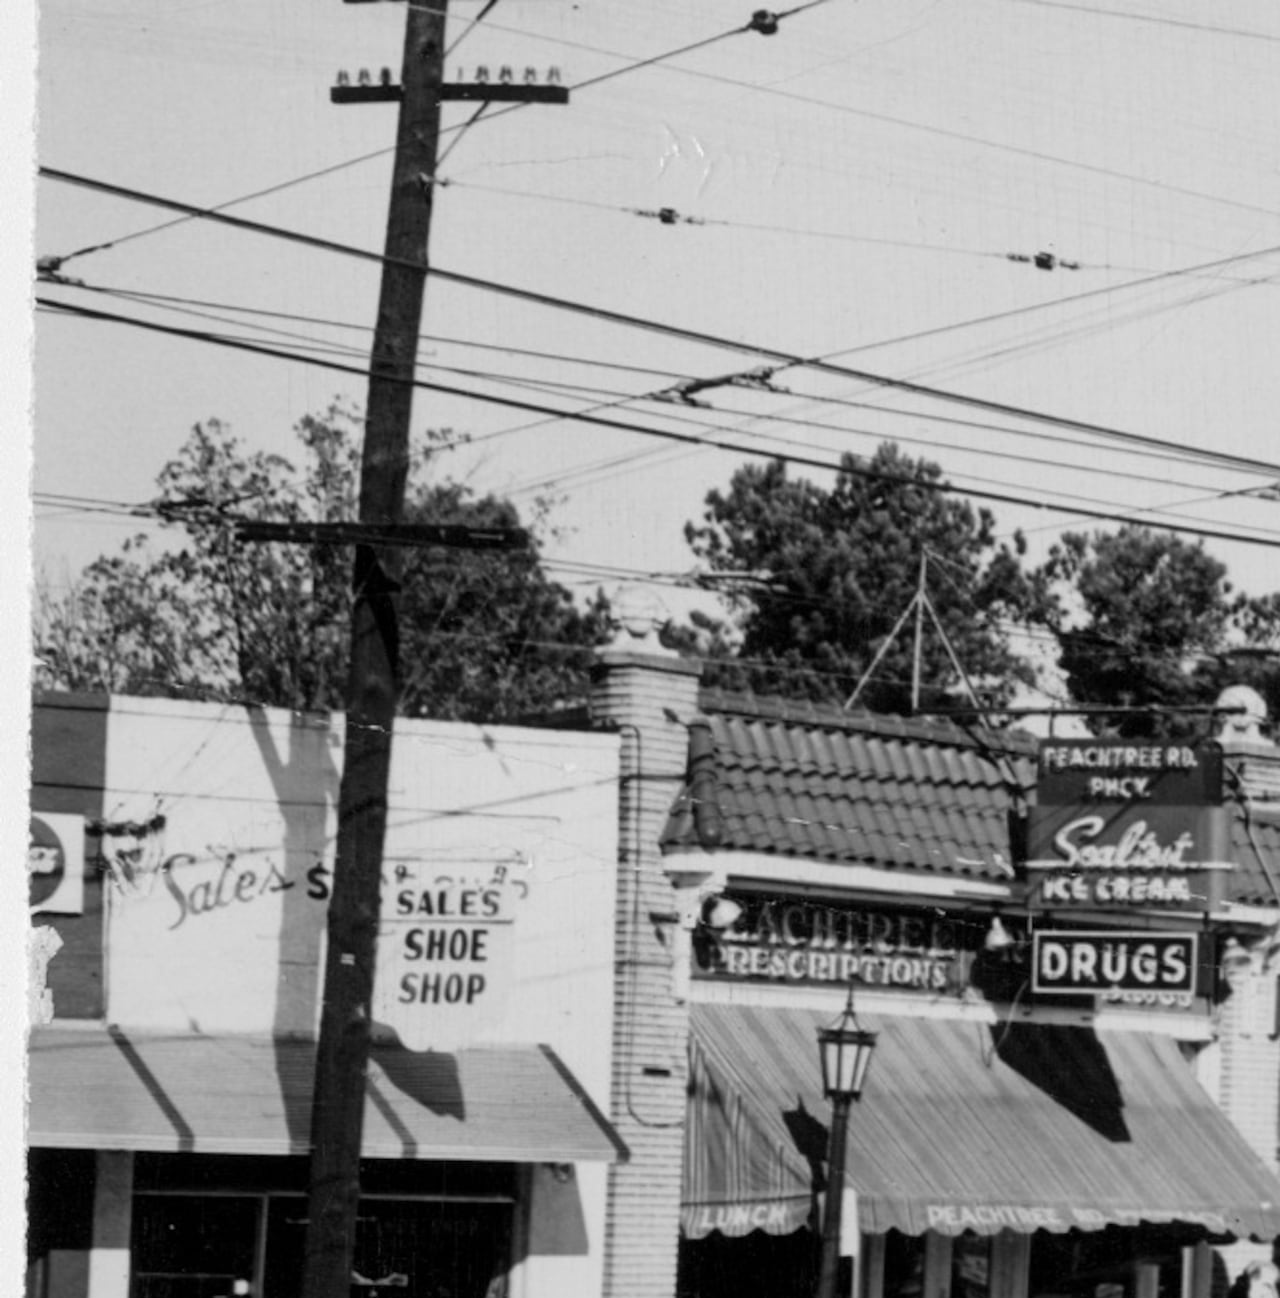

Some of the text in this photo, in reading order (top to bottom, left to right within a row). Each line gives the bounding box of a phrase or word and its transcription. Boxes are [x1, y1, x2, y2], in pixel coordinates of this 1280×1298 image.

[1043, 876, 1089, 899] ICE
[403, 928, 489, 962] SHOE
[1041, 942, 1188, 984] DRUGS
[398, 972, 486, 1004] SHOP
[701, 1204, 788, 1229] LUNCH
